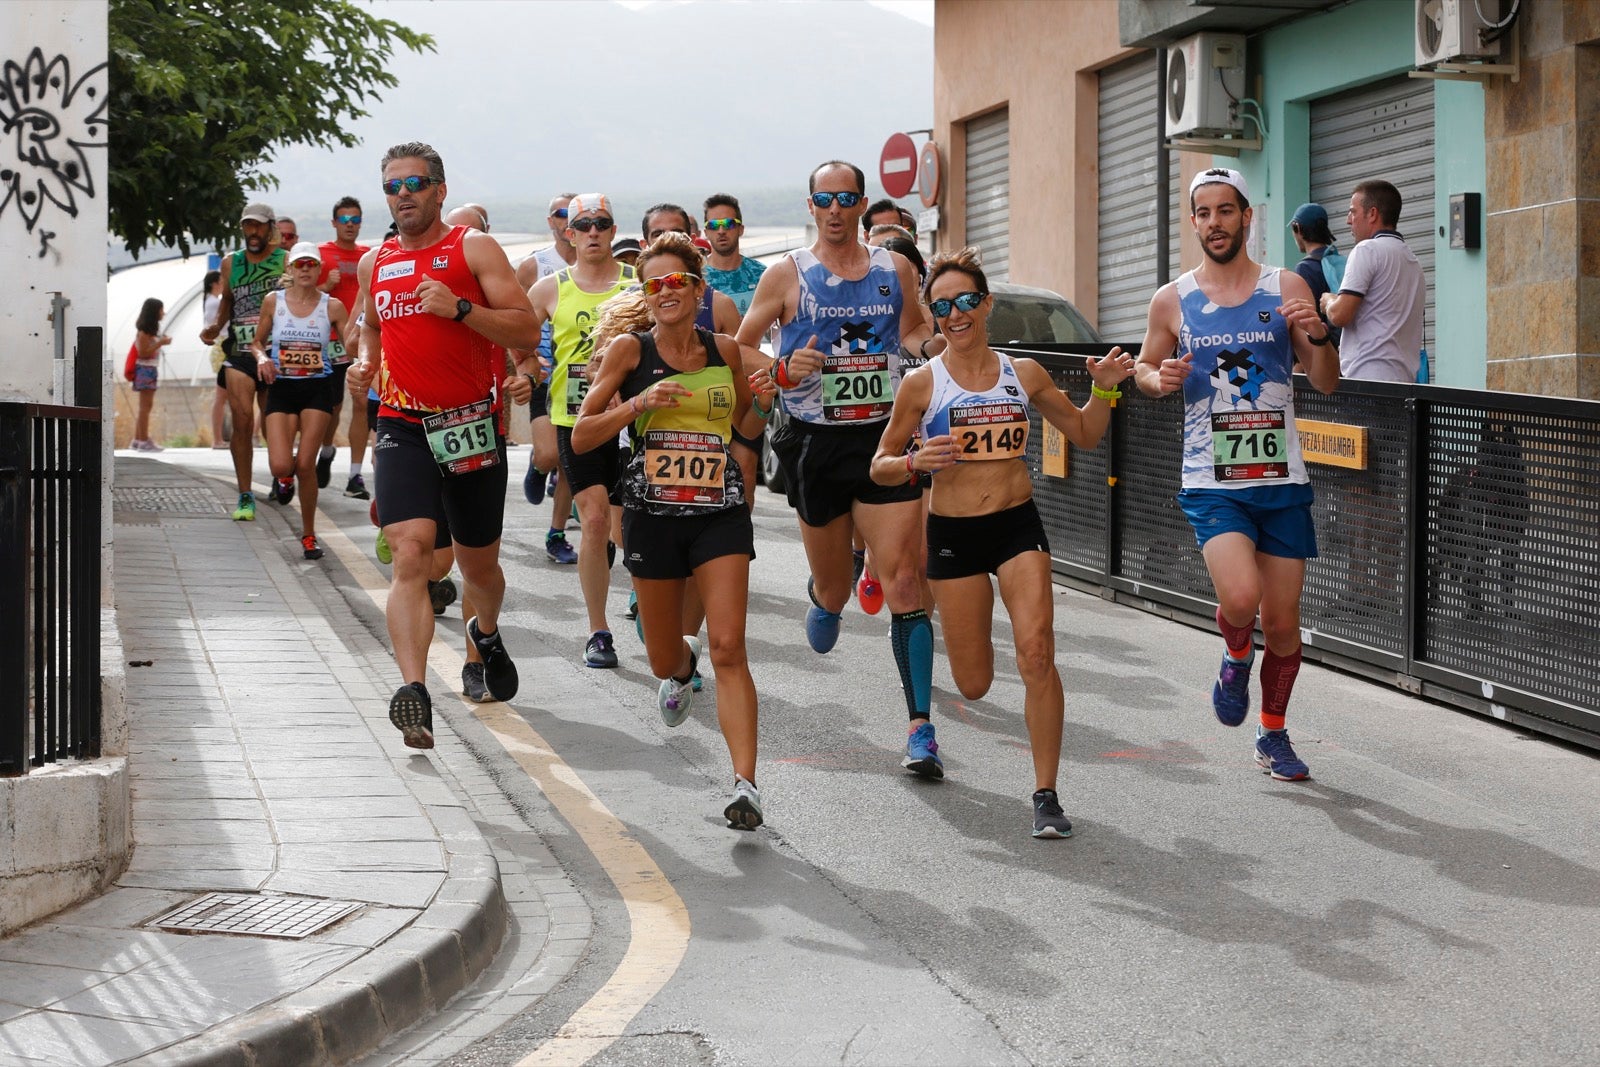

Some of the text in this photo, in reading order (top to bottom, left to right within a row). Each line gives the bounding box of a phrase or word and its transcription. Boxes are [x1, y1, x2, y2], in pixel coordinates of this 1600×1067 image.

[395, 290, 417, 302] Clíni
[820, 304, 895, 318] TODO SUMA
[280, 330, 321, 338] MARACENA
[1194, 331, 1276, 348] TODO SUMA
[285, 353, 320, 365] 2263
[835, 374, 883, 401] 200
[967, 408, 982, 417] GRAN
[983, 406, 1002, 416] PREMIO
[1002, 406, 1009, 414] DE
[1229, 413, 1243, 423] GRAN
[1243, 413, 1262, 422] PREMIO
[1262, 413, 1268, 421] DE
[443, 423, 488, 455] 615
[649, 432, 664, 441] XXXII
[664, 433, 679, 441] GRAN
[679, 433, 698, 442] PREMIO
[698, 435, 705, 443] DE
[962, 427, 1025, 454] 2149
[1297, 431, 1356, 459] RVEZAS ALHAMBRA
[1226, 433, 1278, 459] 716
[656, 455, 722, 481] 2107
